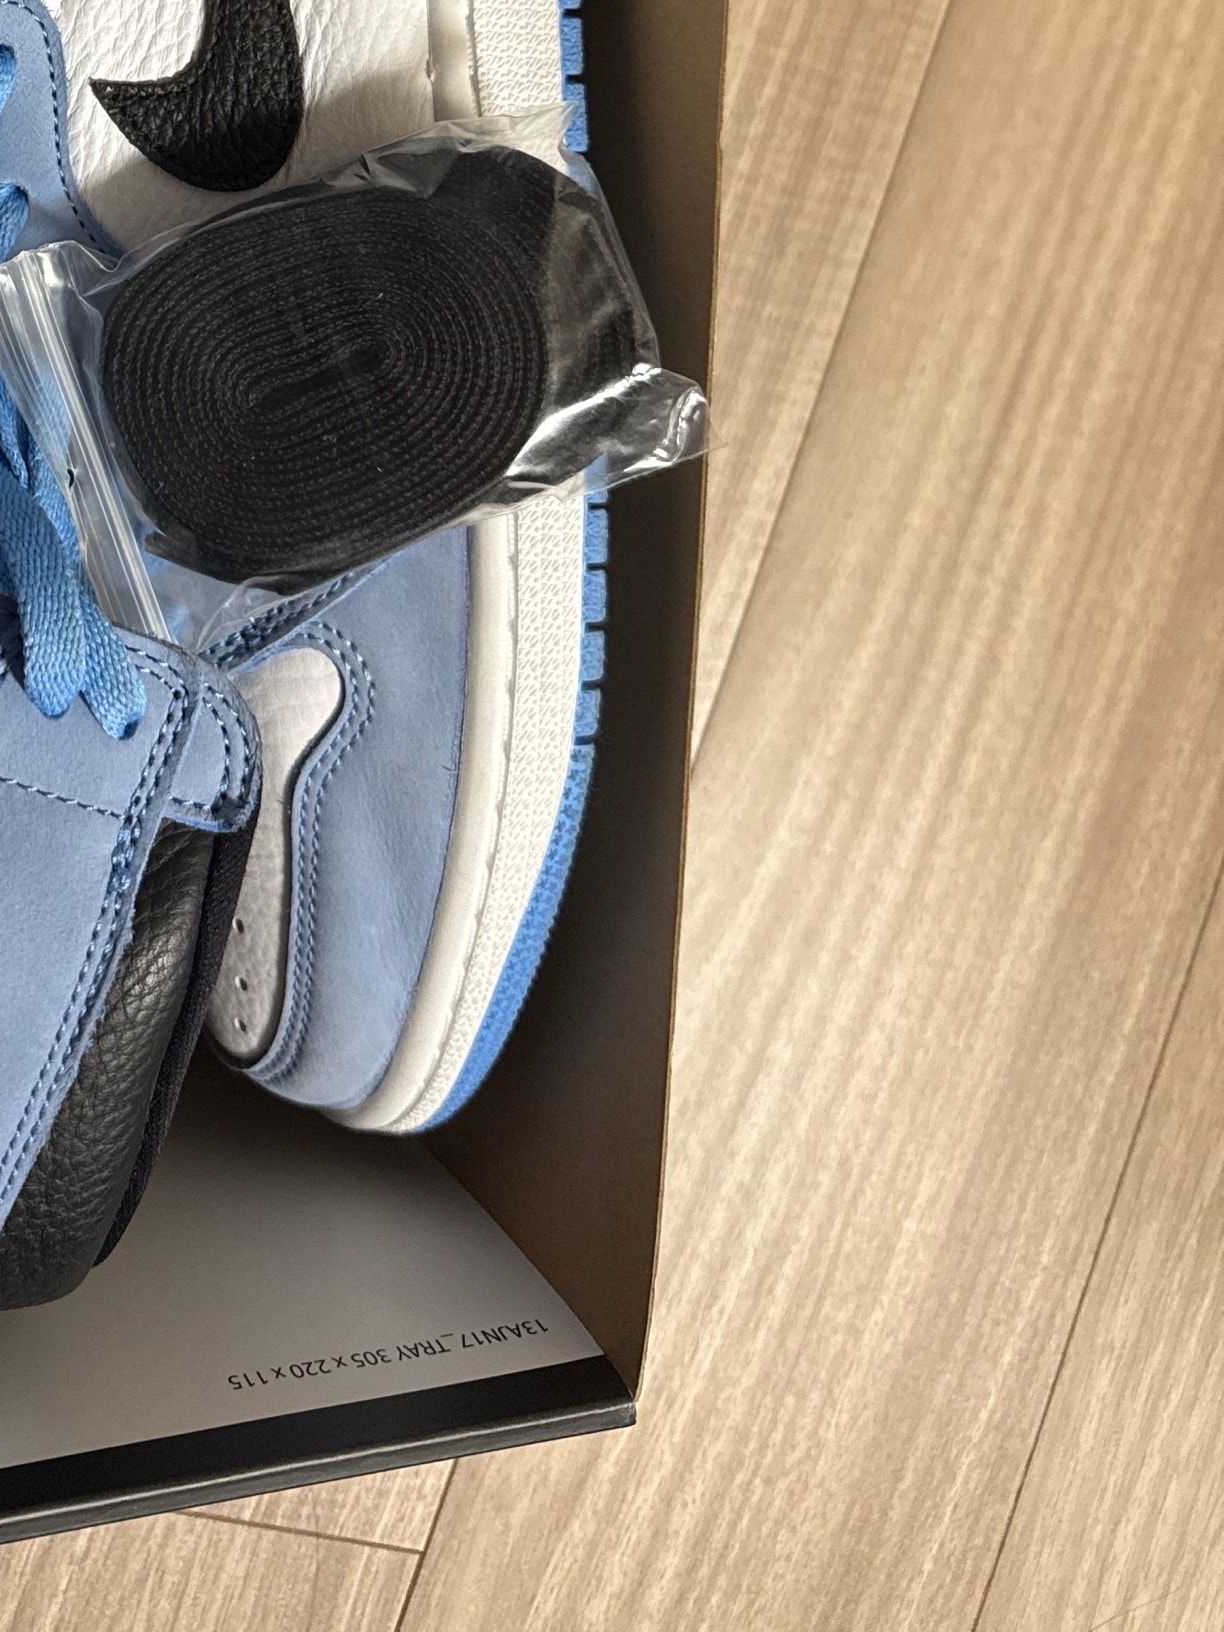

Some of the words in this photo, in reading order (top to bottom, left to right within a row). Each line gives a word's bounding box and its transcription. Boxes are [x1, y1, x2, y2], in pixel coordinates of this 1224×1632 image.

[351, 1347, 392, 1369] 305
[227, 1367, 269, 1391] 115
[289, 1359, 331, 1380] 220
